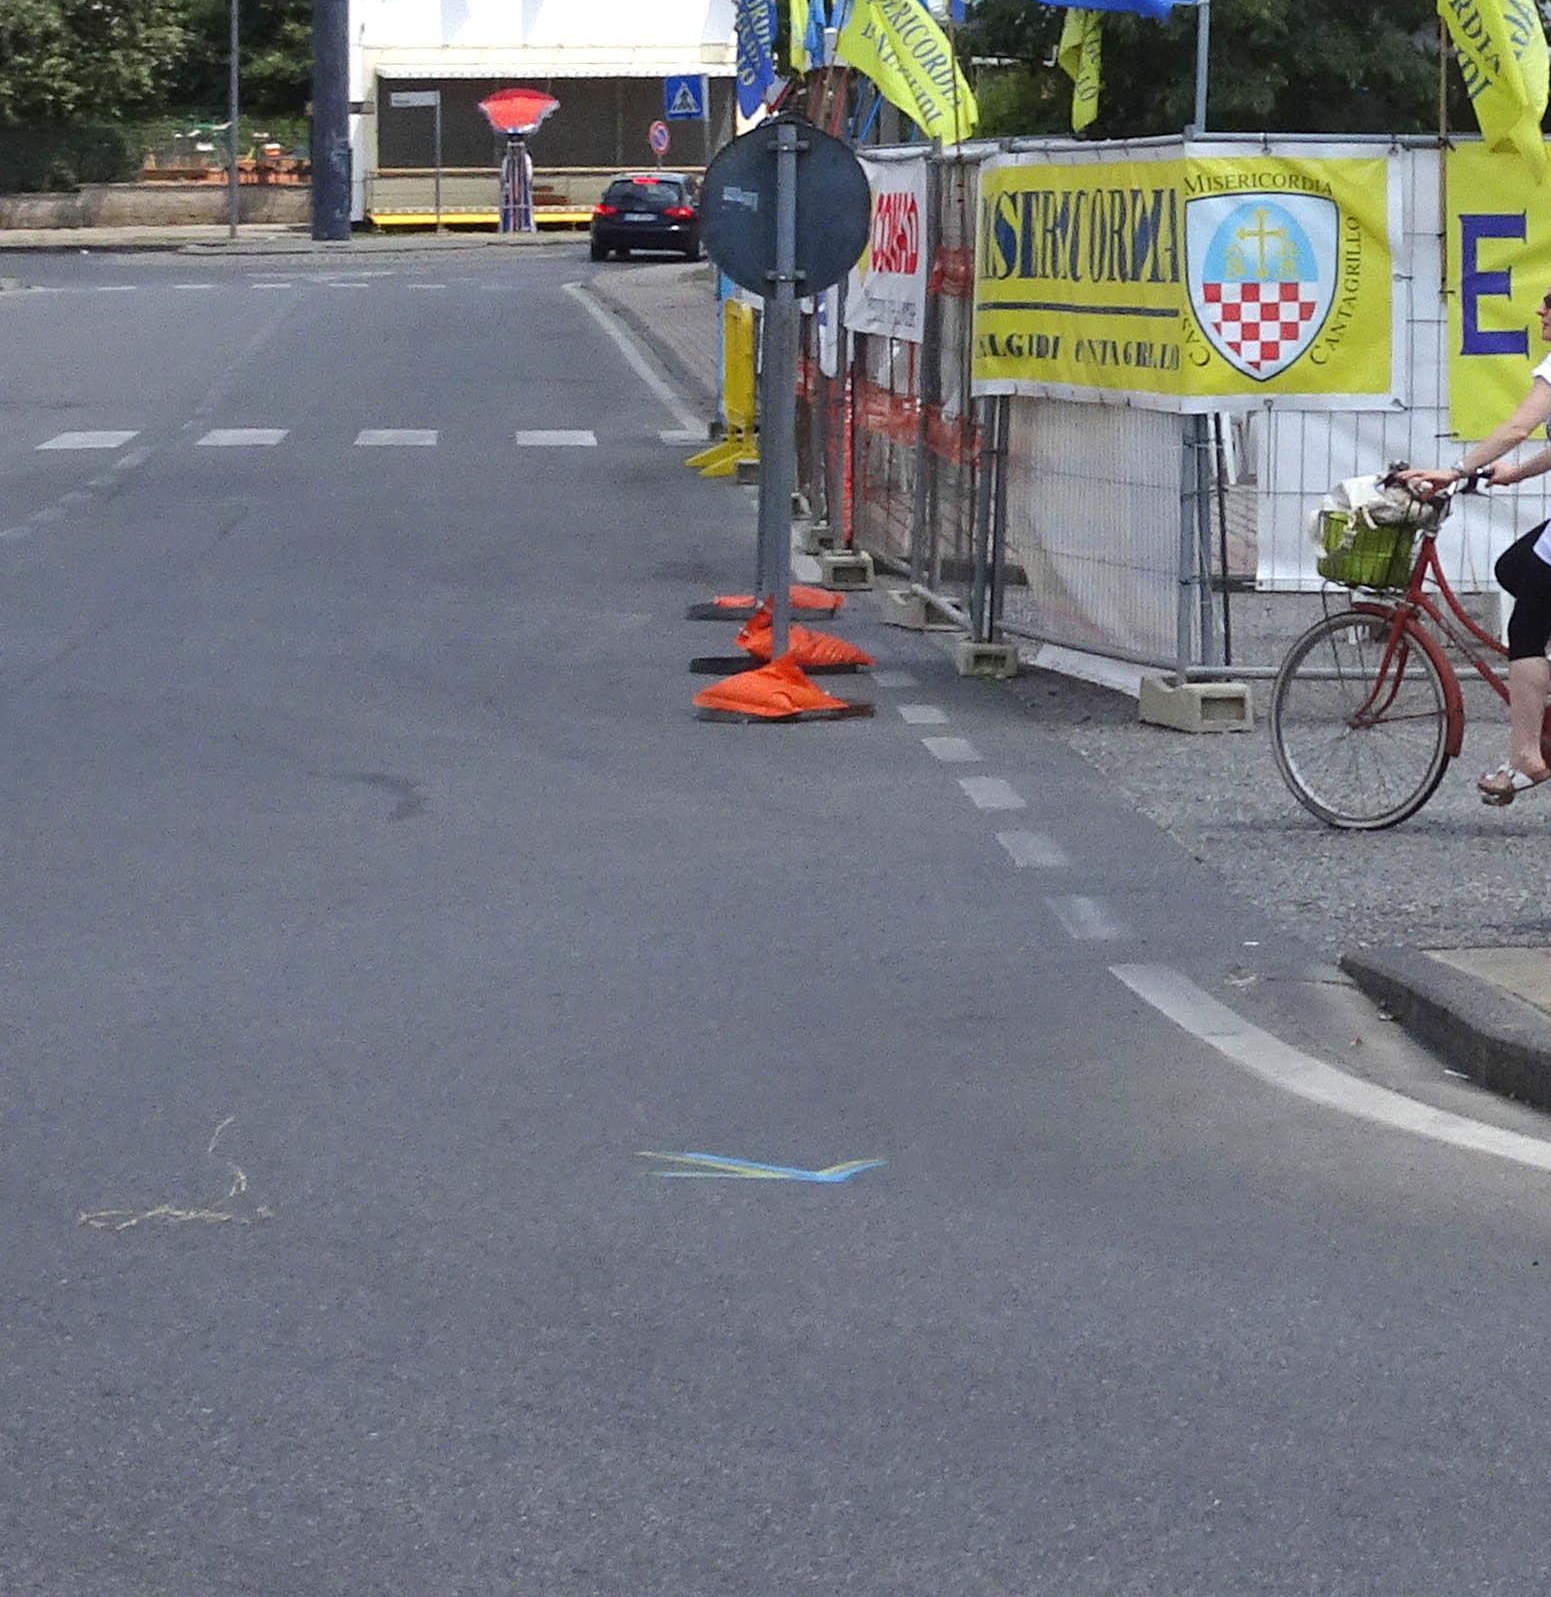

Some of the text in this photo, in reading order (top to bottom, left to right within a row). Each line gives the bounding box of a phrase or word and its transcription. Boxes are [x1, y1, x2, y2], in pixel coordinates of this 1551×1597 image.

[1184, 172, 1334, 197] MISERICORDIA
[1309, 215, 1362, 366] CANTAGRILLO
[1458, 213, 1530, 356] E
